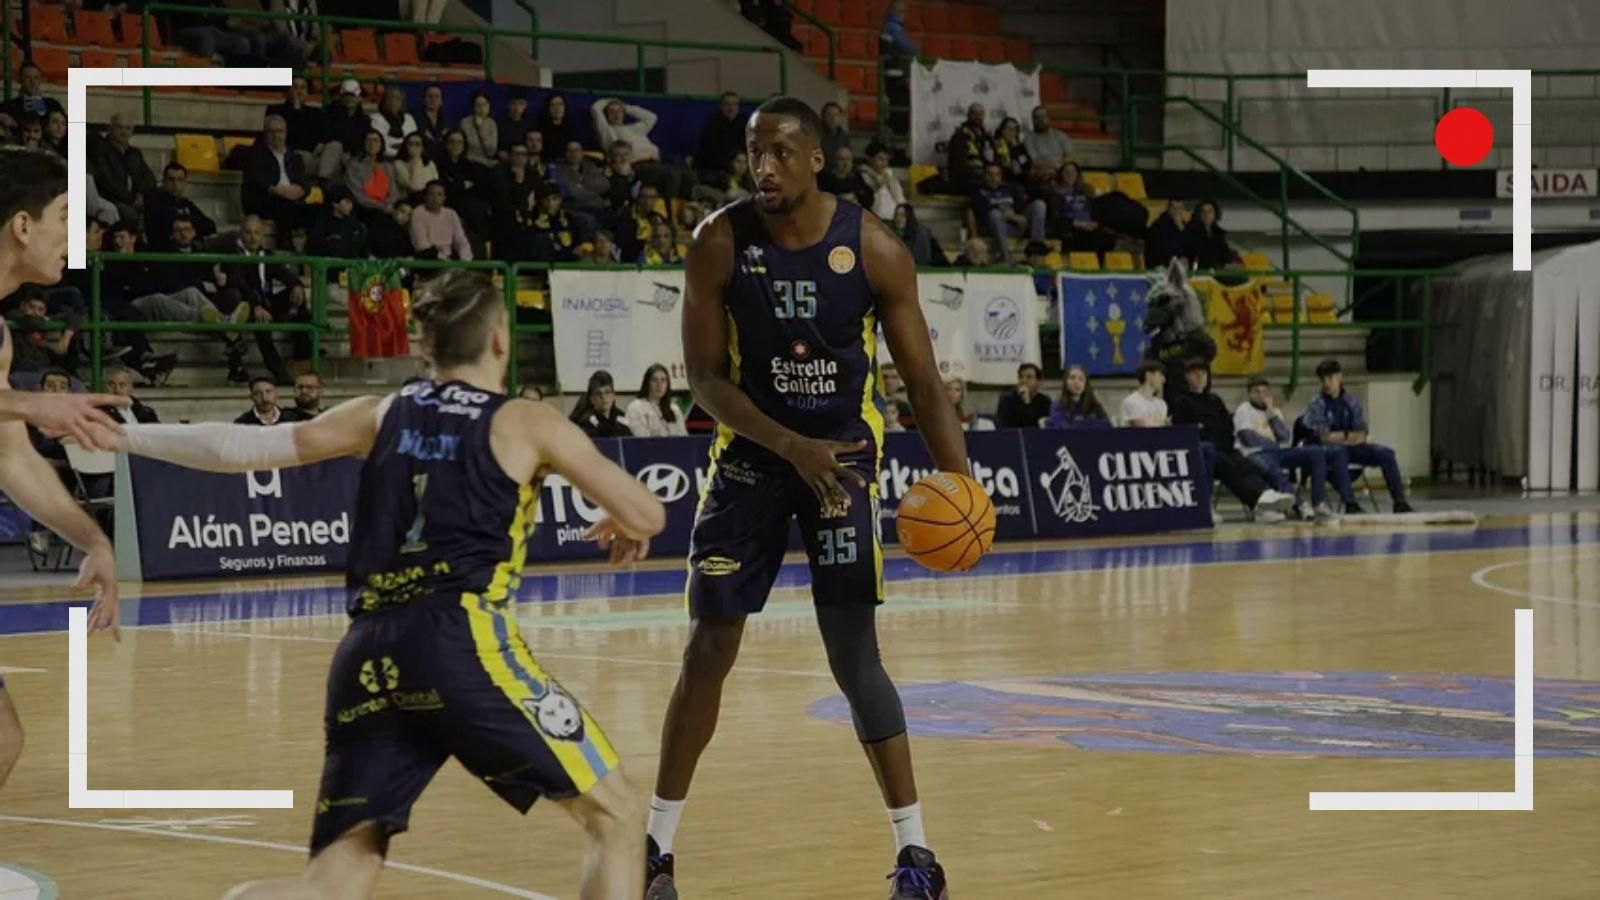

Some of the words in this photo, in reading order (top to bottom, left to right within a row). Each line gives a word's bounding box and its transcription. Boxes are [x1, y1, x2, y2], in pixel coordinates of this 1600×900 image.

[1505, 173, 1588, 194] SAIDA
[773, 280, 817, 319] 35
[771, 357, 838, 377] Estrella
[773, 374, 837, 395] Galicia
[1098, 450, 1190, 481] CLIVET
[1103, 480, 1198, 512] OURENSE
[168, 514, 244, 549] Alán
[249, 512, 353, 547] Pened
[817, 526, 858, 566] 35
[219, 556, 266, 571] Seguros
[266, 557, 275, 570] y
[277, 554, 327, 567] Finanzas
